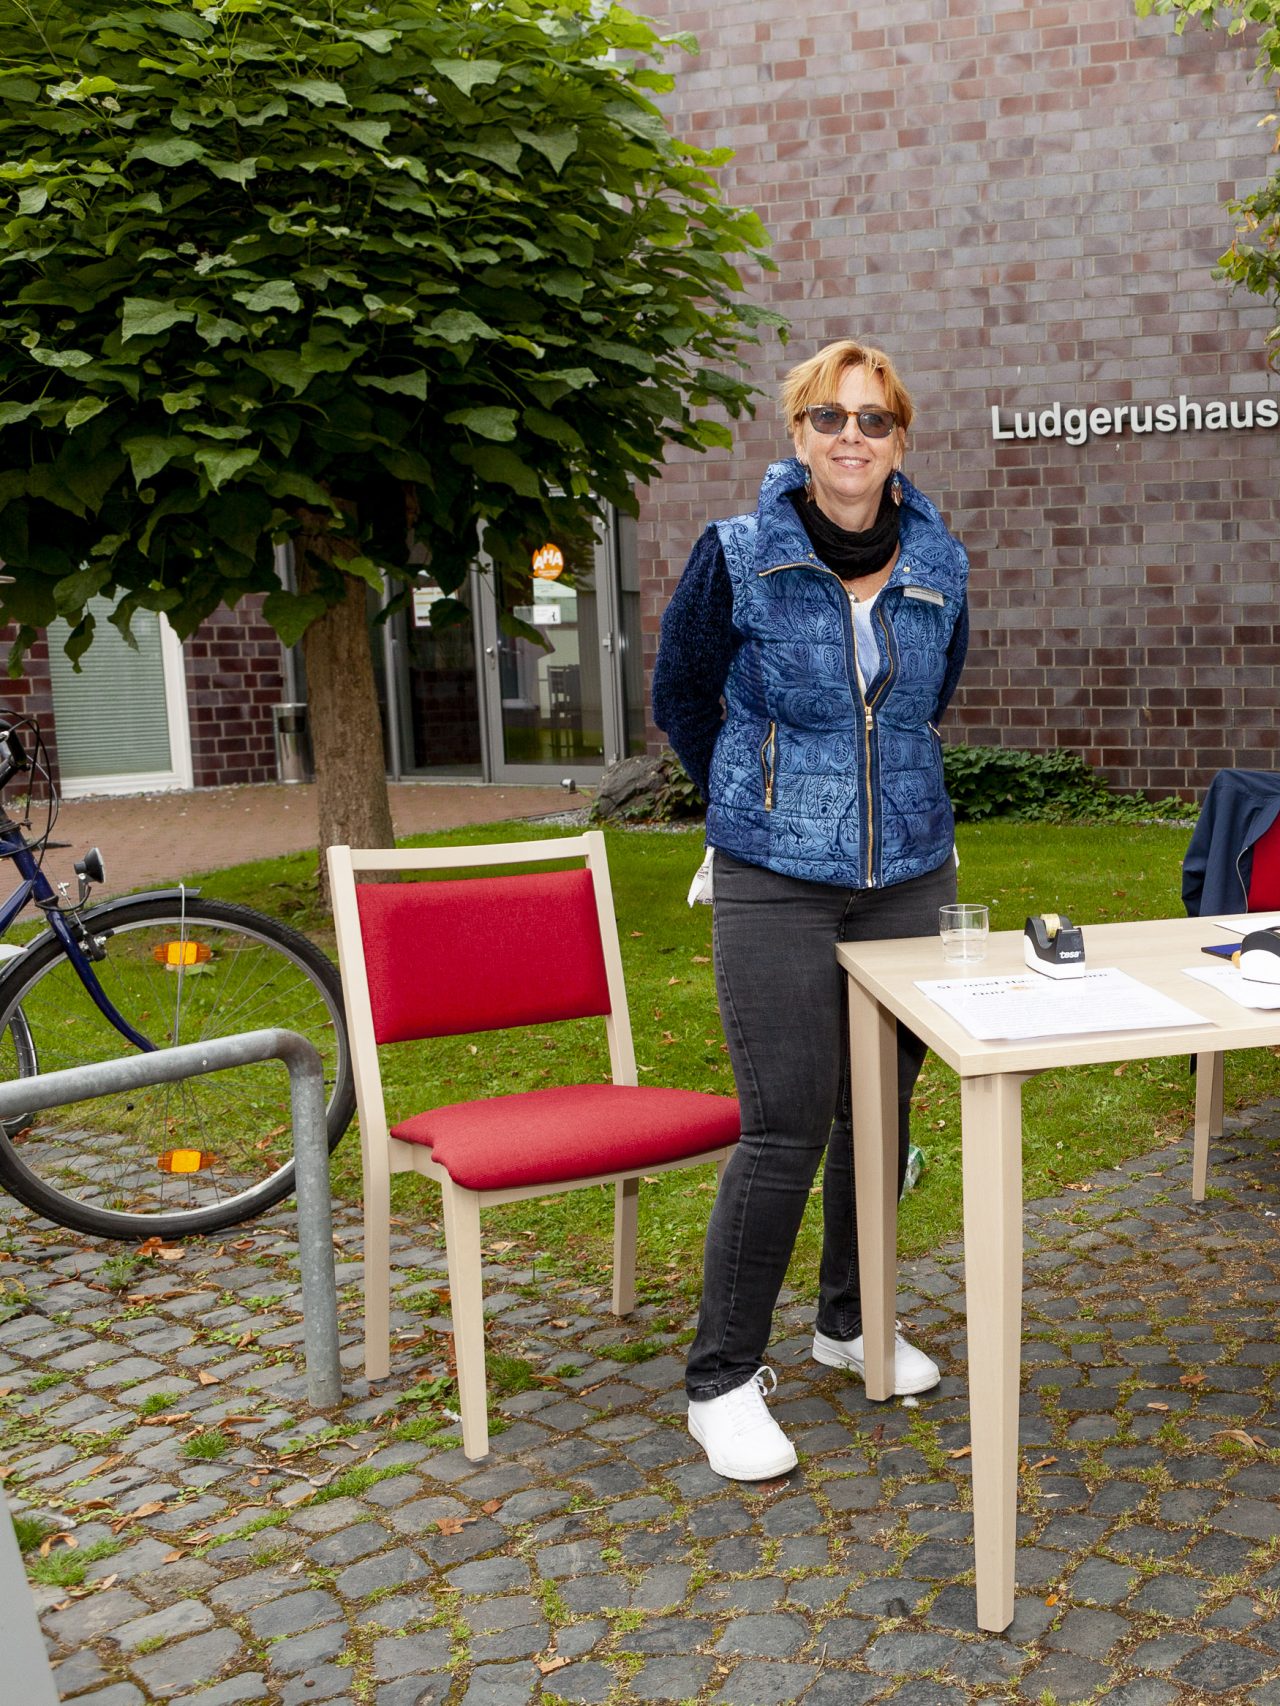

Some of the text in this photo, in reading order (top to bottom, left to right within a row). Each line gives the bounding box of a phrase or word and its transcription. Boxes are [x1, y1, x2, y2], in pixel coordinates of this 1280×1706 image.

[991, 394, 1279, 446] Ludgerushaus
[533, 549, 563, 570] AHA
[1059, 950, 1081, 959] tesa
